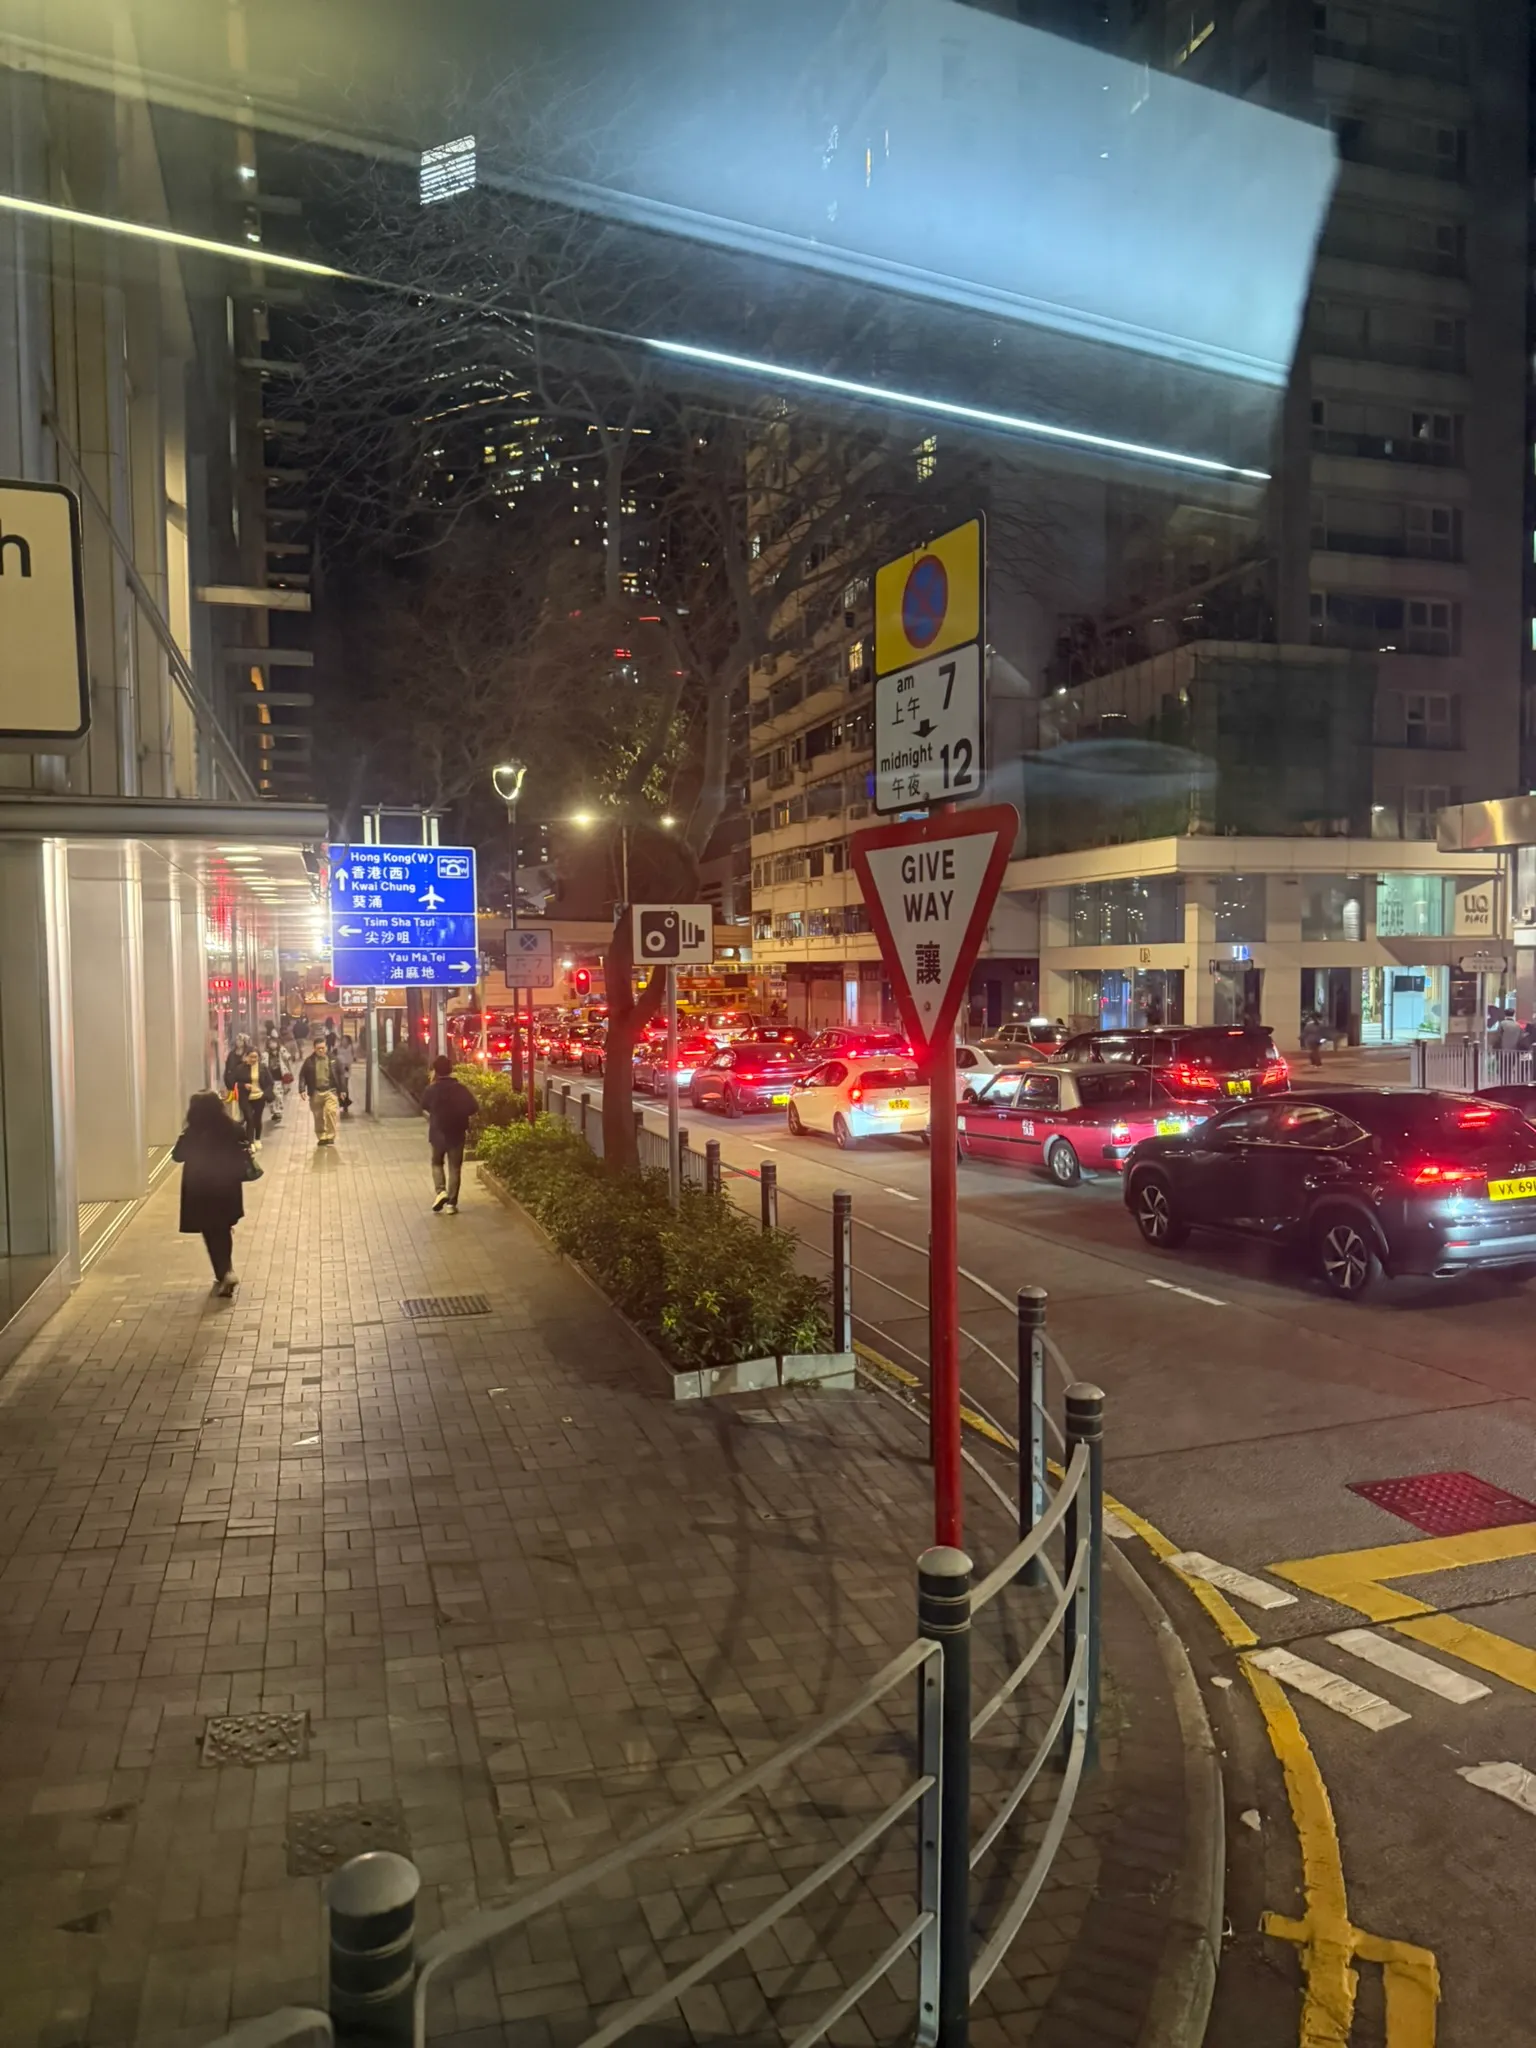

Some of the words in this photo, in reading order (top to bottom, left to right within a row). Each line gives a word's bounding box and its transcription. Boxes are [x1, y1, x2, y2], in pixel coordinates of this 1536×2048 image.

[896, 674, 915, 694] am
[938, 661, 957, 710] 7
[891, 696, 920, 726] 上午
[880, 742, 933, 773] midnight
[940, 738, 972, 789] 12
[891, 772, 921, 799] 午夜
[350, 852, 380, 864] Hong
[351, 865, 410, 880] 香港(西)
[901, 849, 955, 884] GIVE
[351, 881, 378, 891] Kwai
[380, 881, 416, 893] Chung
[352, 895, 383, 909] 葵涌
[903, 890, 954, 923] WAY
[363, 917, 388, 927] Tsim
[391, 917, 411, 927] Sha
[413, 917, 435, 927] Tsui
[364, 930, 411, 944] 尖沙咀
[388, 952, 409, 962] Yau
[411, 952, 428, 962] Ma
[429, 952, 446, 962] Tei
[536, 958, 543, 969] 7
[915, 941, 941, 984] 讓
[390, 966, 435, 979] 油麻地
[536, 975, 550, 985] 12
[1498, 1183, 1514, 1195] VX
